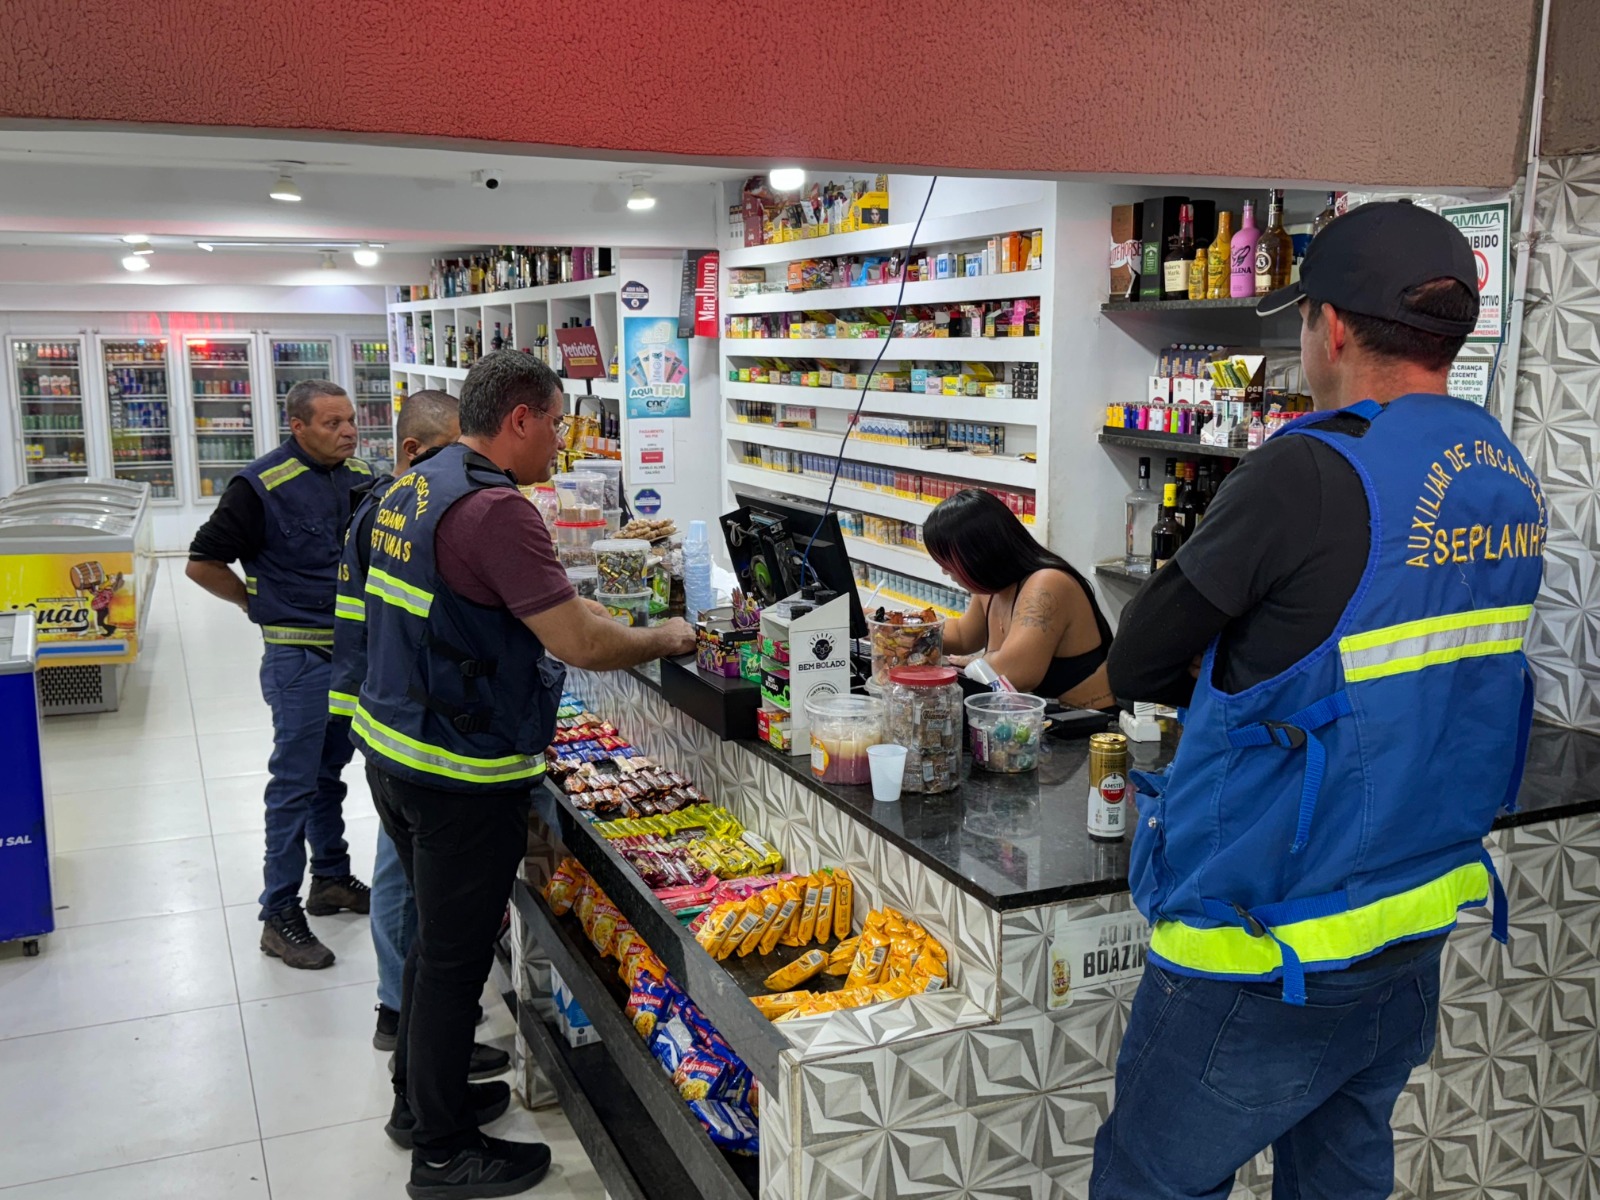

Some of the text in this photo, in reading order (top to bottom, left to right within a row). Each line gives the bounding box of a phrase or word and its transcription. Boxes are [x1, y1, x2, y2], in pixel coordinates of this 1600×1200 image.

[1451, 212, 1501, 226] AMMA
[1469, 234, 1499, 249] IBIDO
[695, 263, 716, 322] Marlboro
[1480, 295, 1500, 307] OTIVO
[562, 343, 598, 357] Peticitos
[652, 383, 685, 397] TEM
[1247, 385, 1263, 393] OCB
[1405, 461, 1453, 568] AUXILIAR
[1443, 442, 1472, 473] DE
[1433, 522, 1540, 566] SEPLANH
[798, 659, 846, 671] BEM BOLADO
[6, 834, 32, 847] SAL
[1083, 940, 1150, 979] BOAZIN
